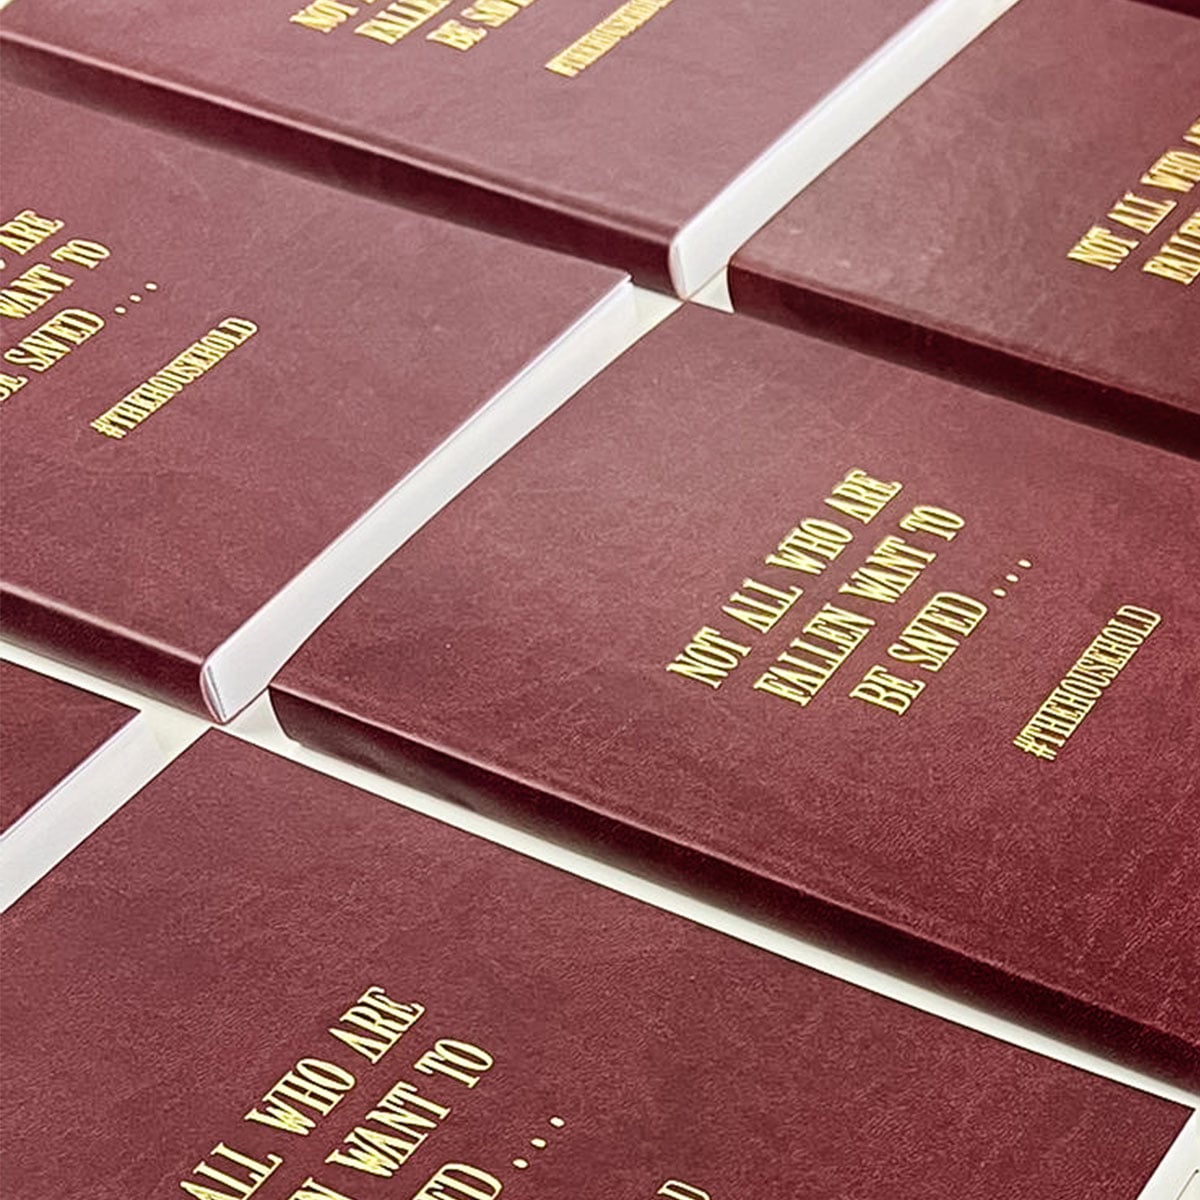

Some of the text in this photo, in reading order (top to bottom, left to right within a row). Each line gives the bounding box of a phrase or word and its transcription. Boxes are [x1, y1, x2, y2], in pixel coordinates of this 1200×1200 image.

[50, 239, 111, 270] TO
[1066, 225, 1141, 273] NOT
[1106, 191, 1178, 236] ALL
[89, 317, 260, 440] #THEHOUSEHOLD
[666, 467, 903, 689] NOT ALL WHO ARE
[753, 504, 966, 707] FALLEN WANT TO
[849, 664, 926, 716] BE
[1013, 604, 1162, 762] #THEHOUSEHOLD
[244, 1056, 357, 1136] WHO
[328, 985, 426, 1065] ARE
[325, 1080, 451, 1178] WANT
[414, 1037, 496, 1089] TO
